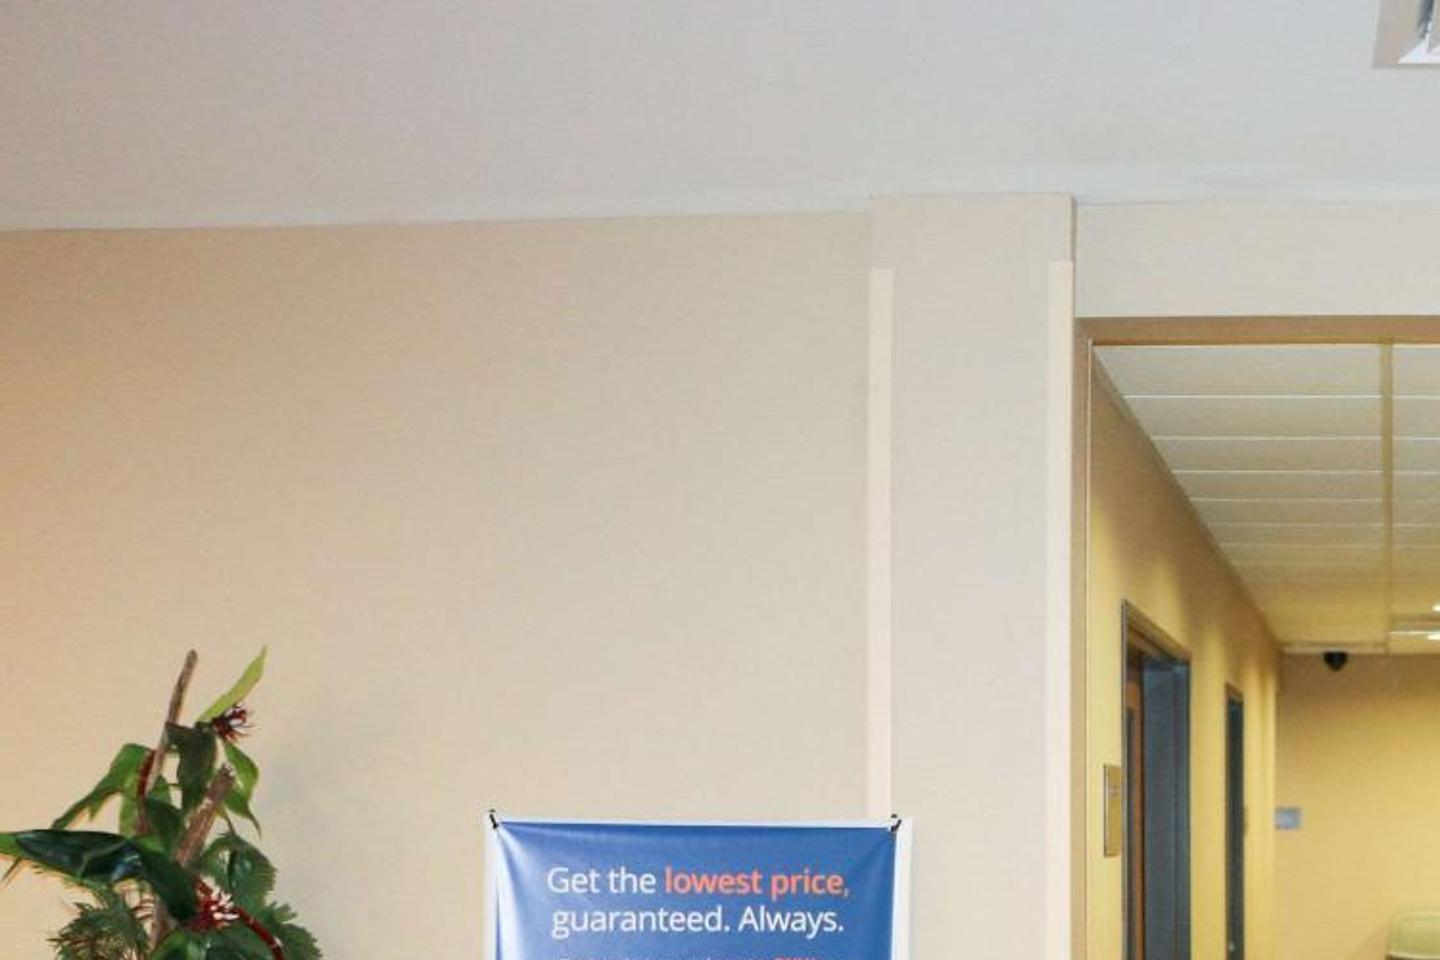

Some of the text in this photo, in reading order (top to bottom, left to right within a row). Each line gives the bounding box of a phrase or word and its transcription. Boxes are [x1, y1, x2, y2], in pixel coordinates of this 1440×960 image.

[547, 866, 851, 905] Get the lowest price,
[551, 904, 844, 940] guaranteed. Always.
